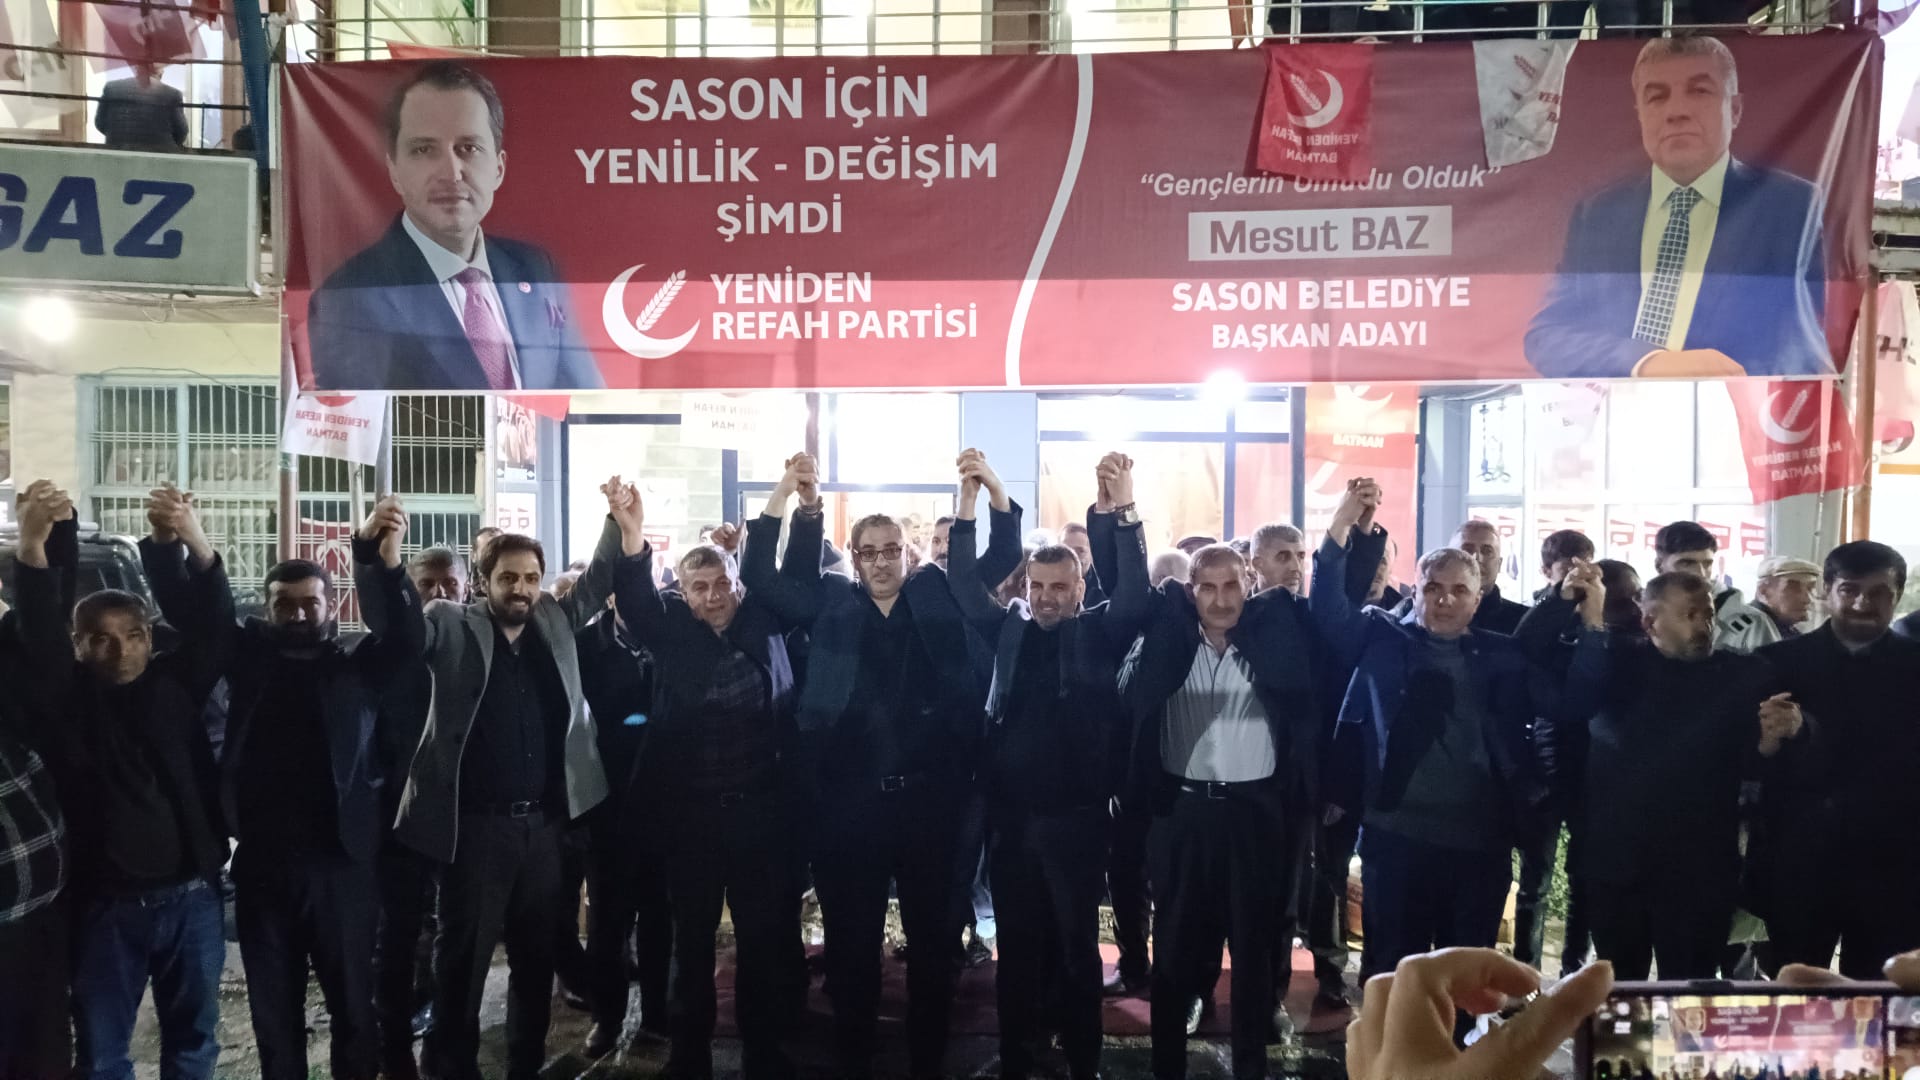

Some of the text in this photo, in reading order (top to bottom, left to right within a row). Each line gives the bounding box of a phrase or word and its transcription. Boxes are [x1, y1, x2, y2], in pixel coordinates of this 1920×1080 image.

[630, 65, 928, 128] SASON İÇİN
[575, 134, 997, 188] YENİLİK - DEĞİŞİM
[716, 193, 842, 242] ŞİMDİ
[1209, 214, 1430, 254] Mesut BAZ
[710, 265, 872, 304] YENİDEN
[1171, 281, 1288, 312] SASON
[711, 303, 977, 341] REFAH PARTİSİ
[1212, 321, 1427, 352] BAŞKAN ADAYI
